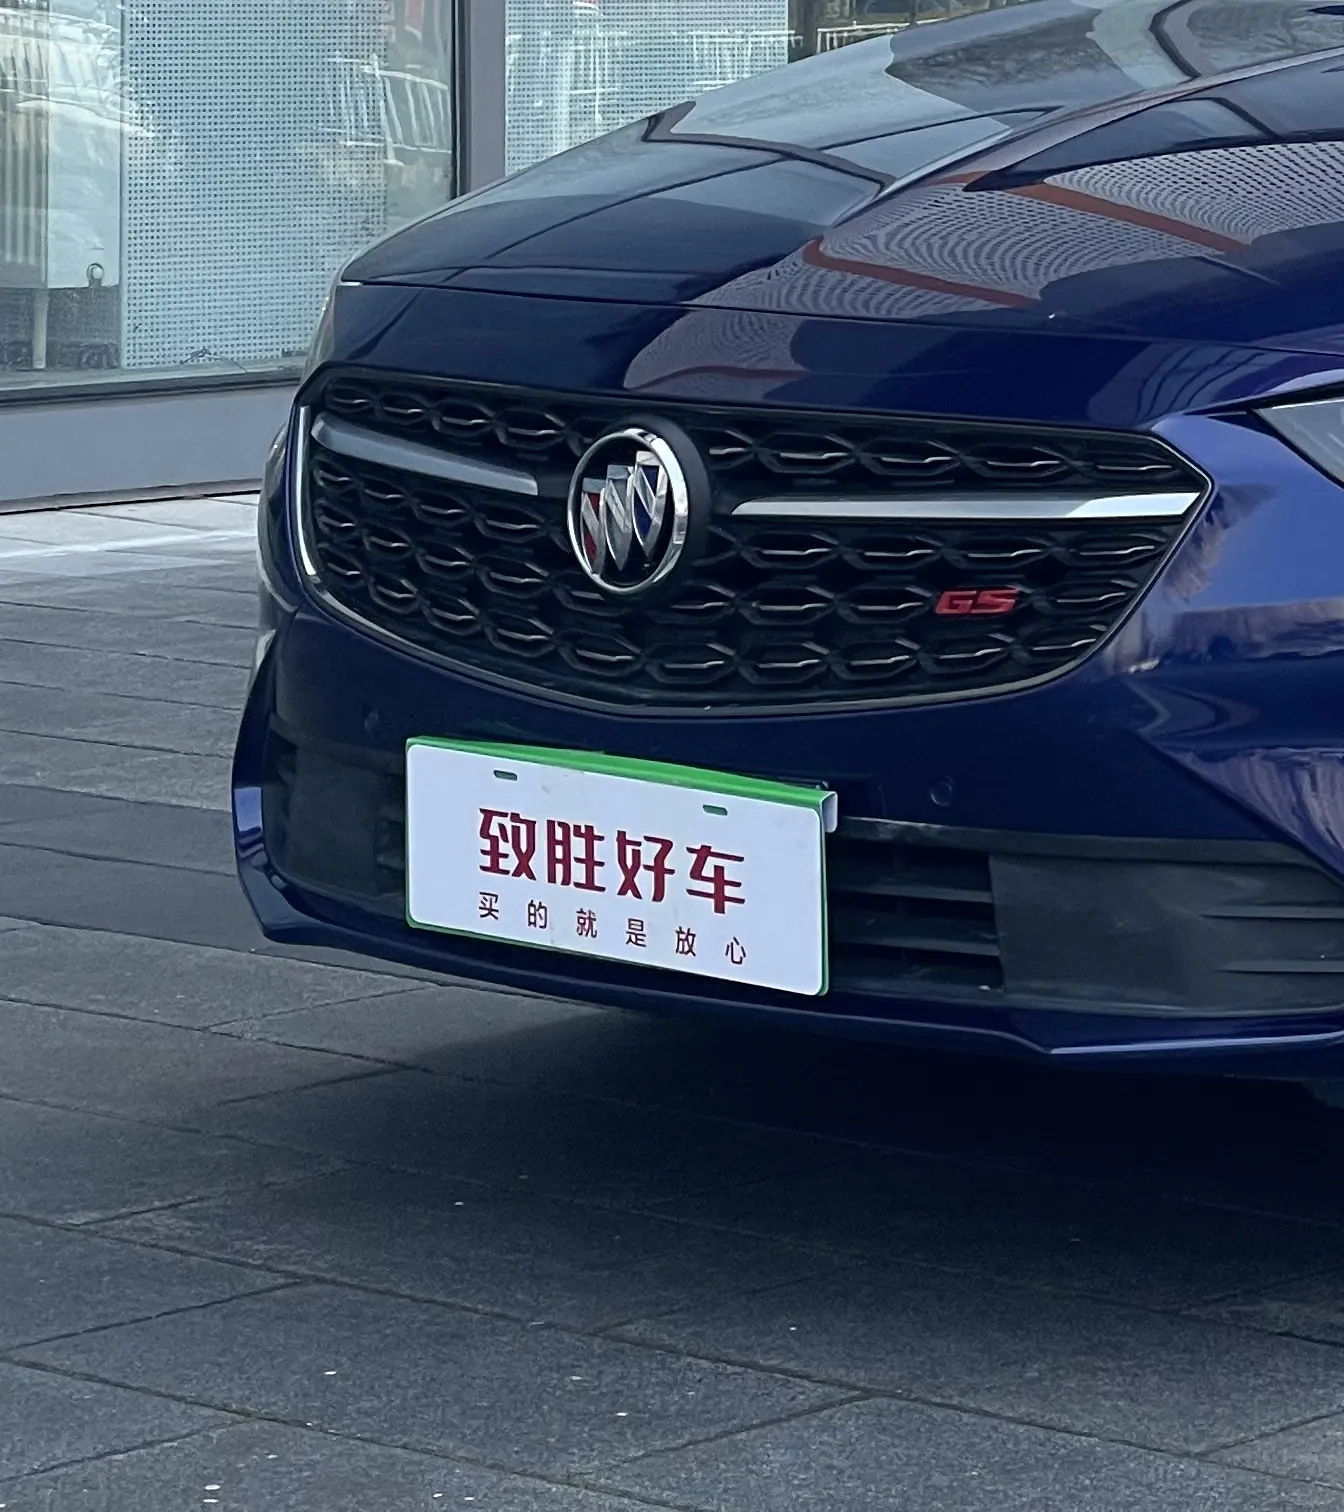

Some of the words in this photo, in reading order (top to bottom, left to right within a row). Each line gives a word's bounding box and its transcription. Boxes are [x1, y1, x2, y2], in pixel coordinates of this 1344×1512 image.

[935, 590, 1019, 614] GS
[479, 807, 745, 915] 致胜好车
[479, 891, 747, 966] 买的就是放心
